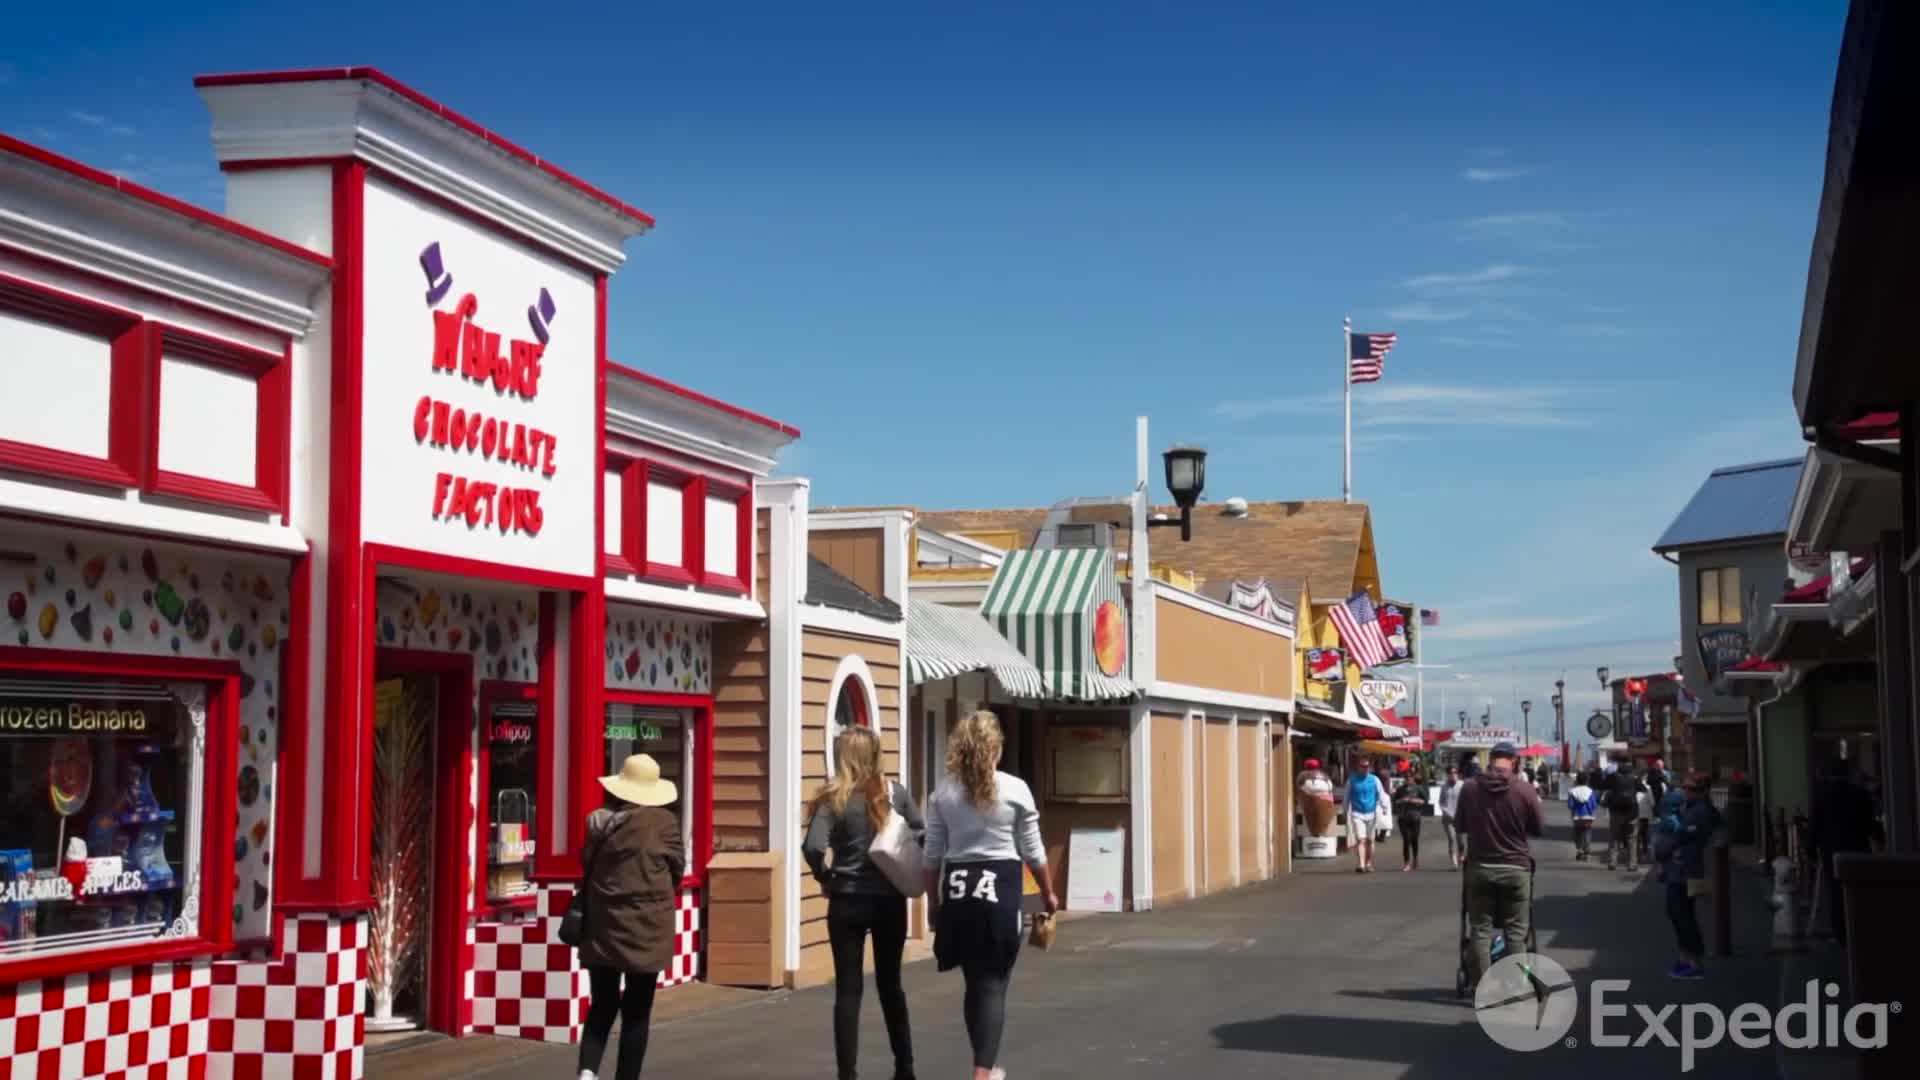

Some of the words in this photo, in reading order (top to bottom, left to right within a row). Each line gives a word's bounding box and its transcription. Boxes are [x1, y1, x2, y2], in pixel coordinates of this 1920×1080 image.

[413, 395, 557, 480] CHOCOLATE
[432, 472, 544, 537] FACTORY
[68, 703, 146, 730] Banana
